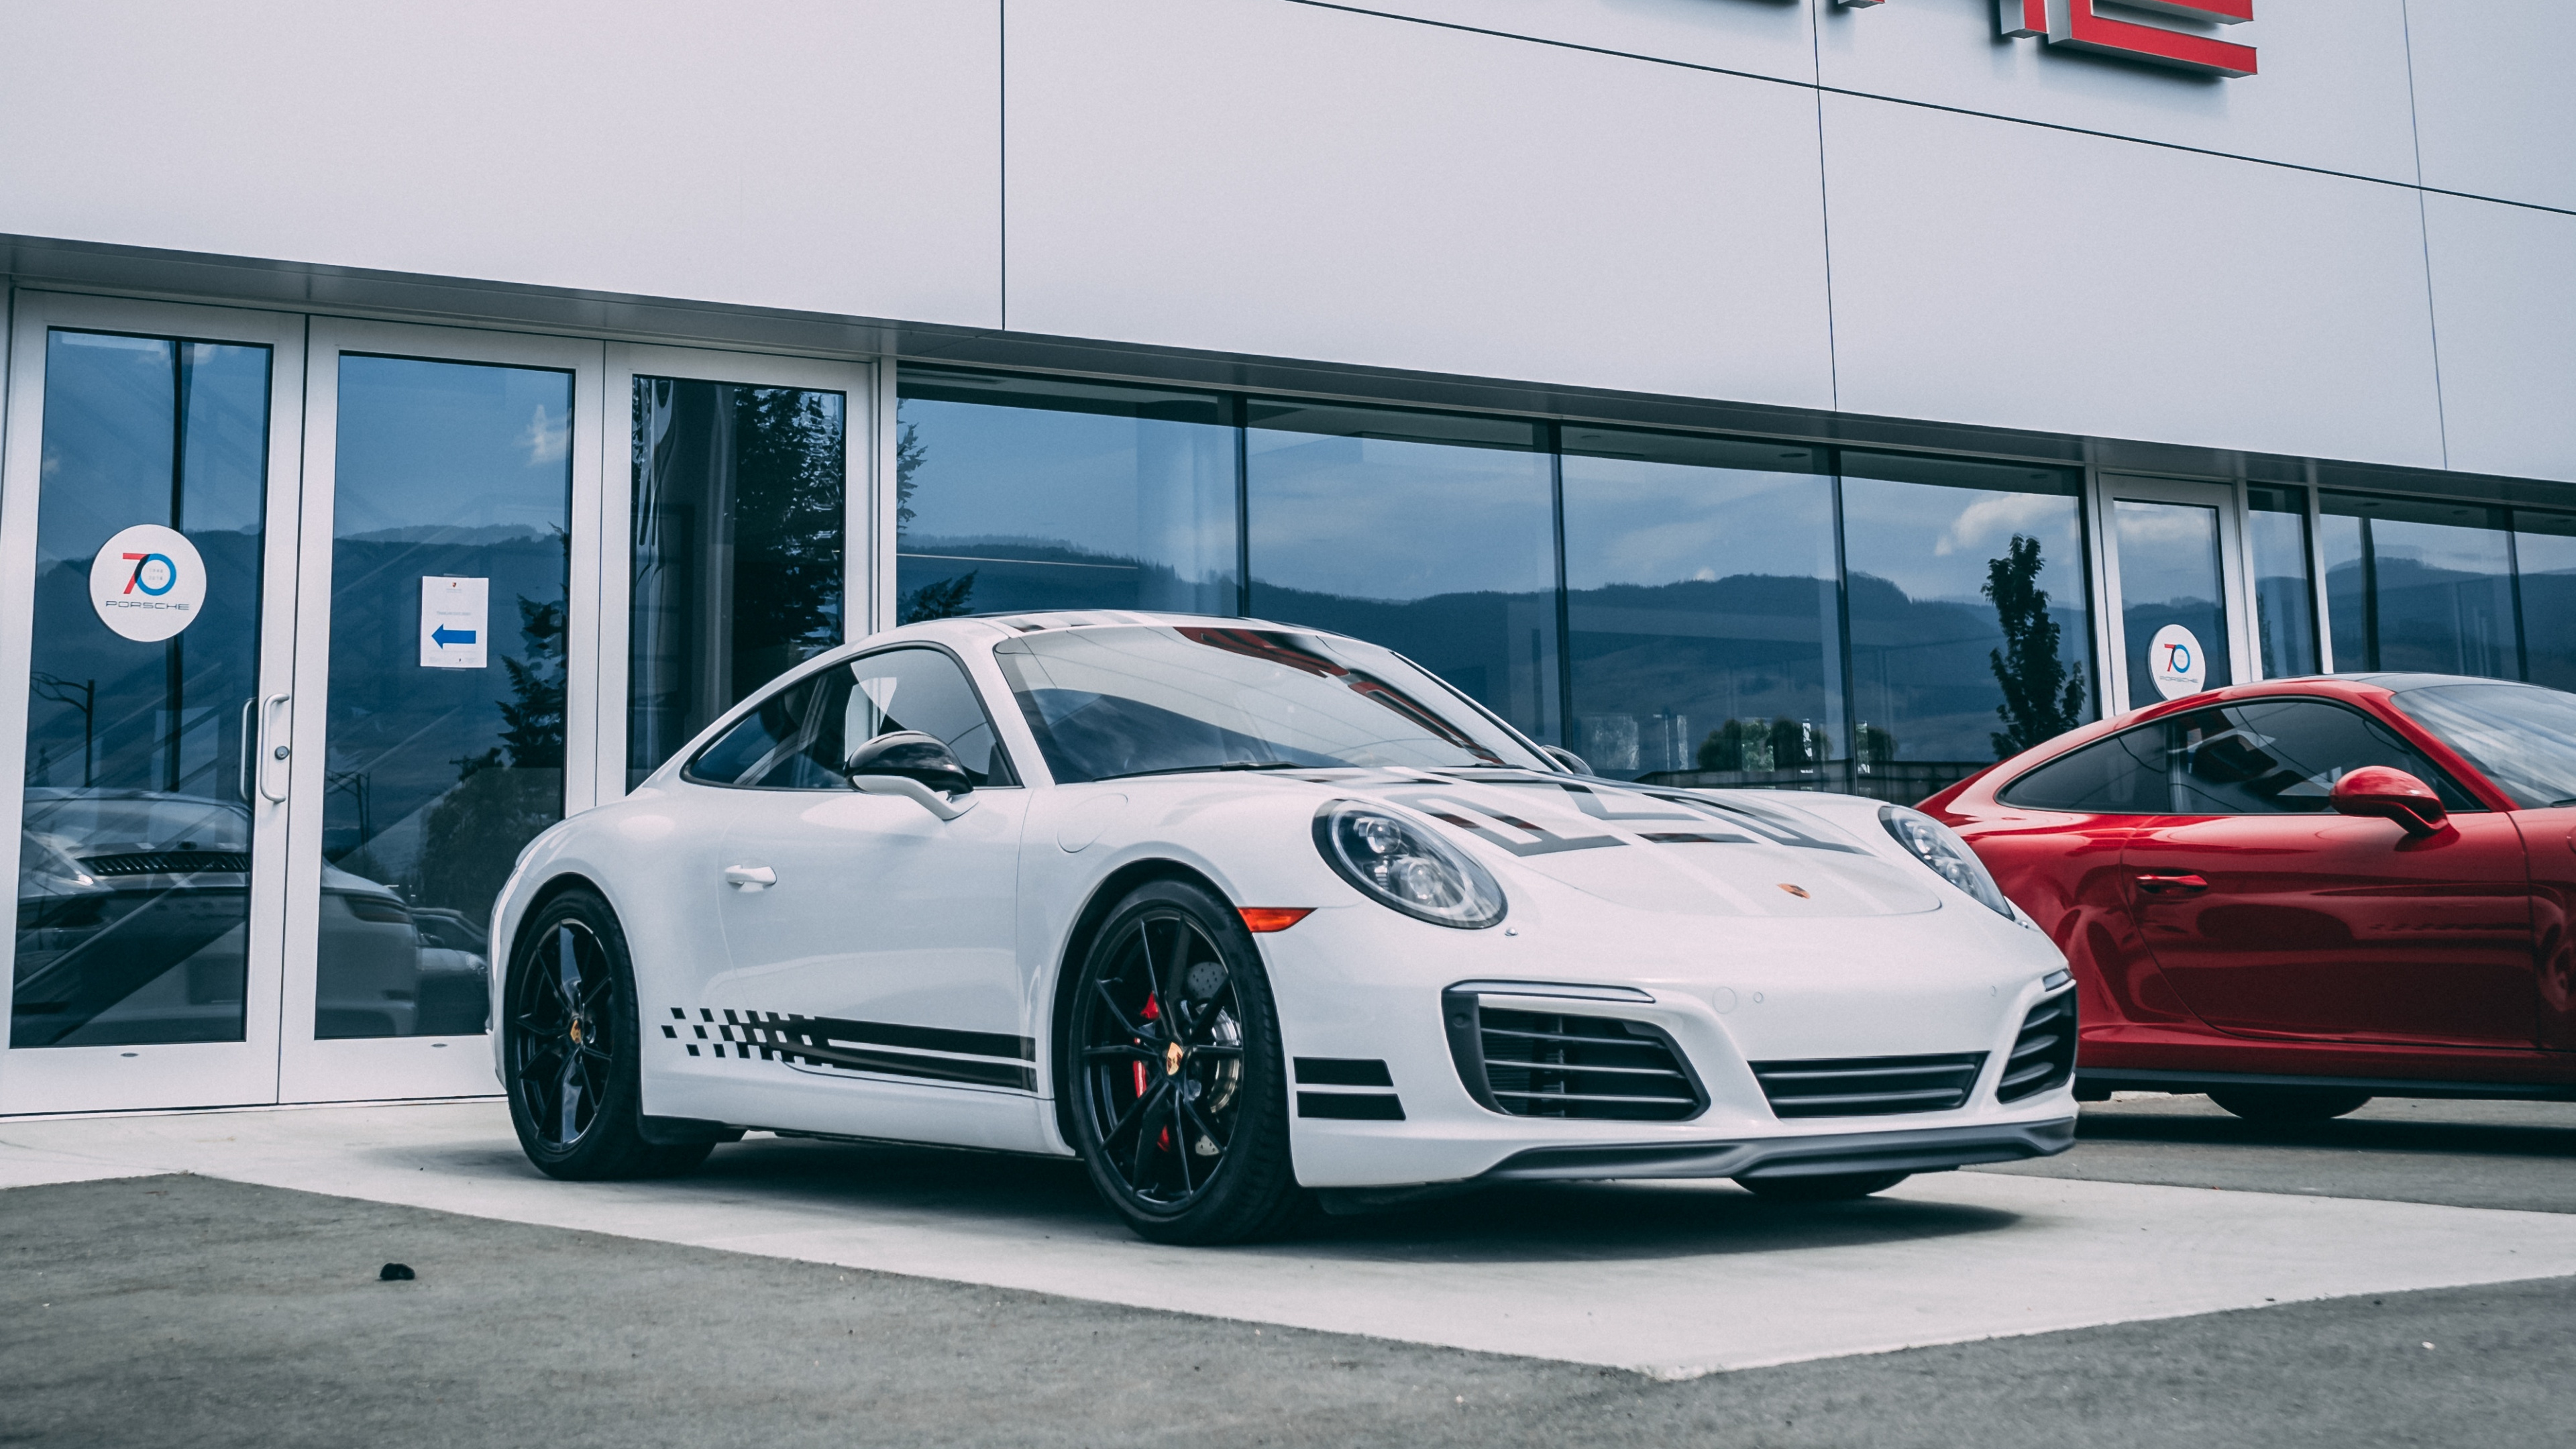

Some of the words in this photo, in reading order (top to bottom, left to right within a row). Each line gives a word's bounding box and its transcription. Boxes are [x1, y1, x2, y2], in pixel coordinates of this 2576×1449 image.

[123, 553, 176, 596] 70
[106, 600, 190, 610] PORSCHE
[2164, 643, 2191, 674] 70
